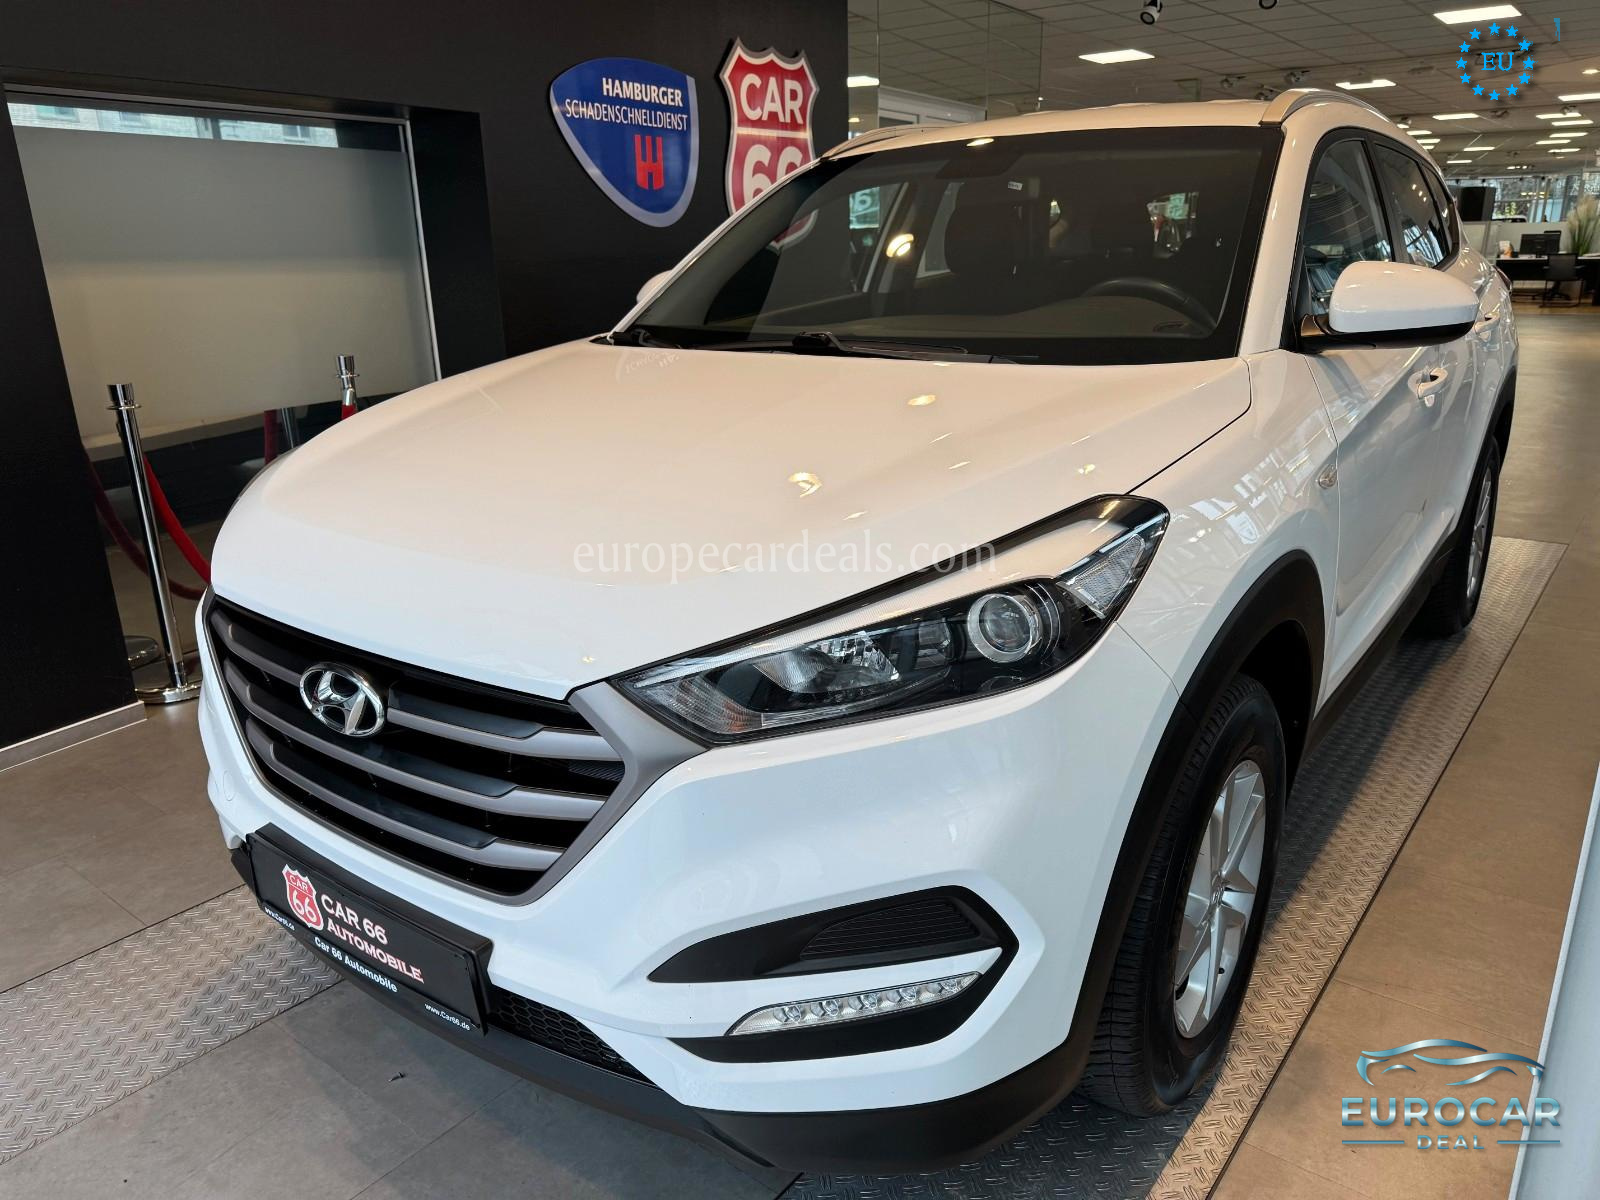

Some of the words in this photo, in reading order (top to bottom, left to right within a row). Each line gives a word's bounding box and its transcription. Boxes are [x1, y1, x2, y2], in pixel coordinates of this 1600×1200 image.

[602, 77, 683, 107] HAMBURGER
[740, 73, 803, 124] CAR
[565, 98, 688, 131] SCHADENSCHNELLDIENST
[290, 875, 309, 893] CAR
[292, 889, 318, 923] 66
[321, 894, 362, 931] CAR
[362, 918, 389, 945] 66
[314, 936, 330, 953] Car
[331, 947, 343, 961] 66
[344, 955, 398, 993] Automobile
[327, 917, 425, 984] AUTOMOBILE
